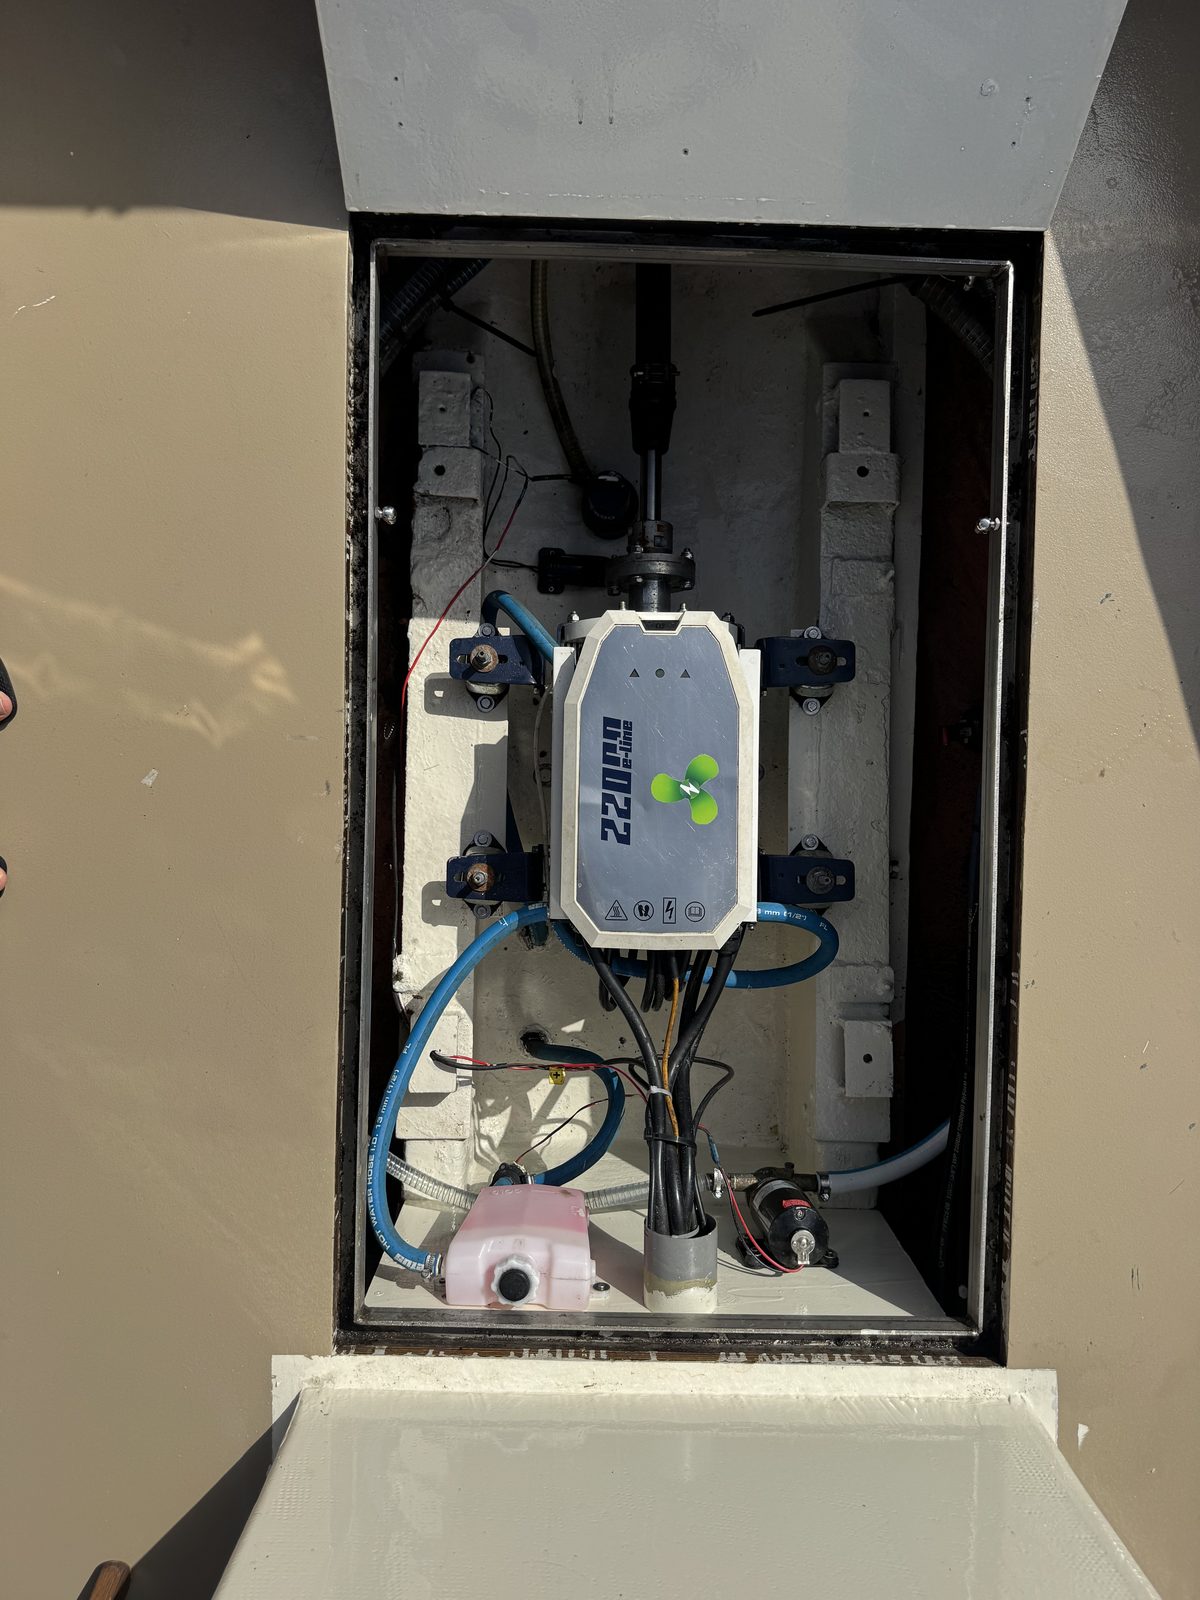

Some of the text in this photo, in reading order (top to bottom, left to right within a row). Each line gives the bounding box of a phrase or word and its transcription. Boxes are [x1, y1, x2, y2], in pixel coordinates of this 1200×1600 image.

[618, 720, 632, 769] e-line
[381, 1096, 390, 1114] mm
[375, 1116, 383, 1129] 13
[370, 1134, 379, 1151] I.D.
[367, 1154, 375, 1185] HOSE
[367, 1188, 378, 1227] WATER
[376, 1229, 391, 1250] HOT
